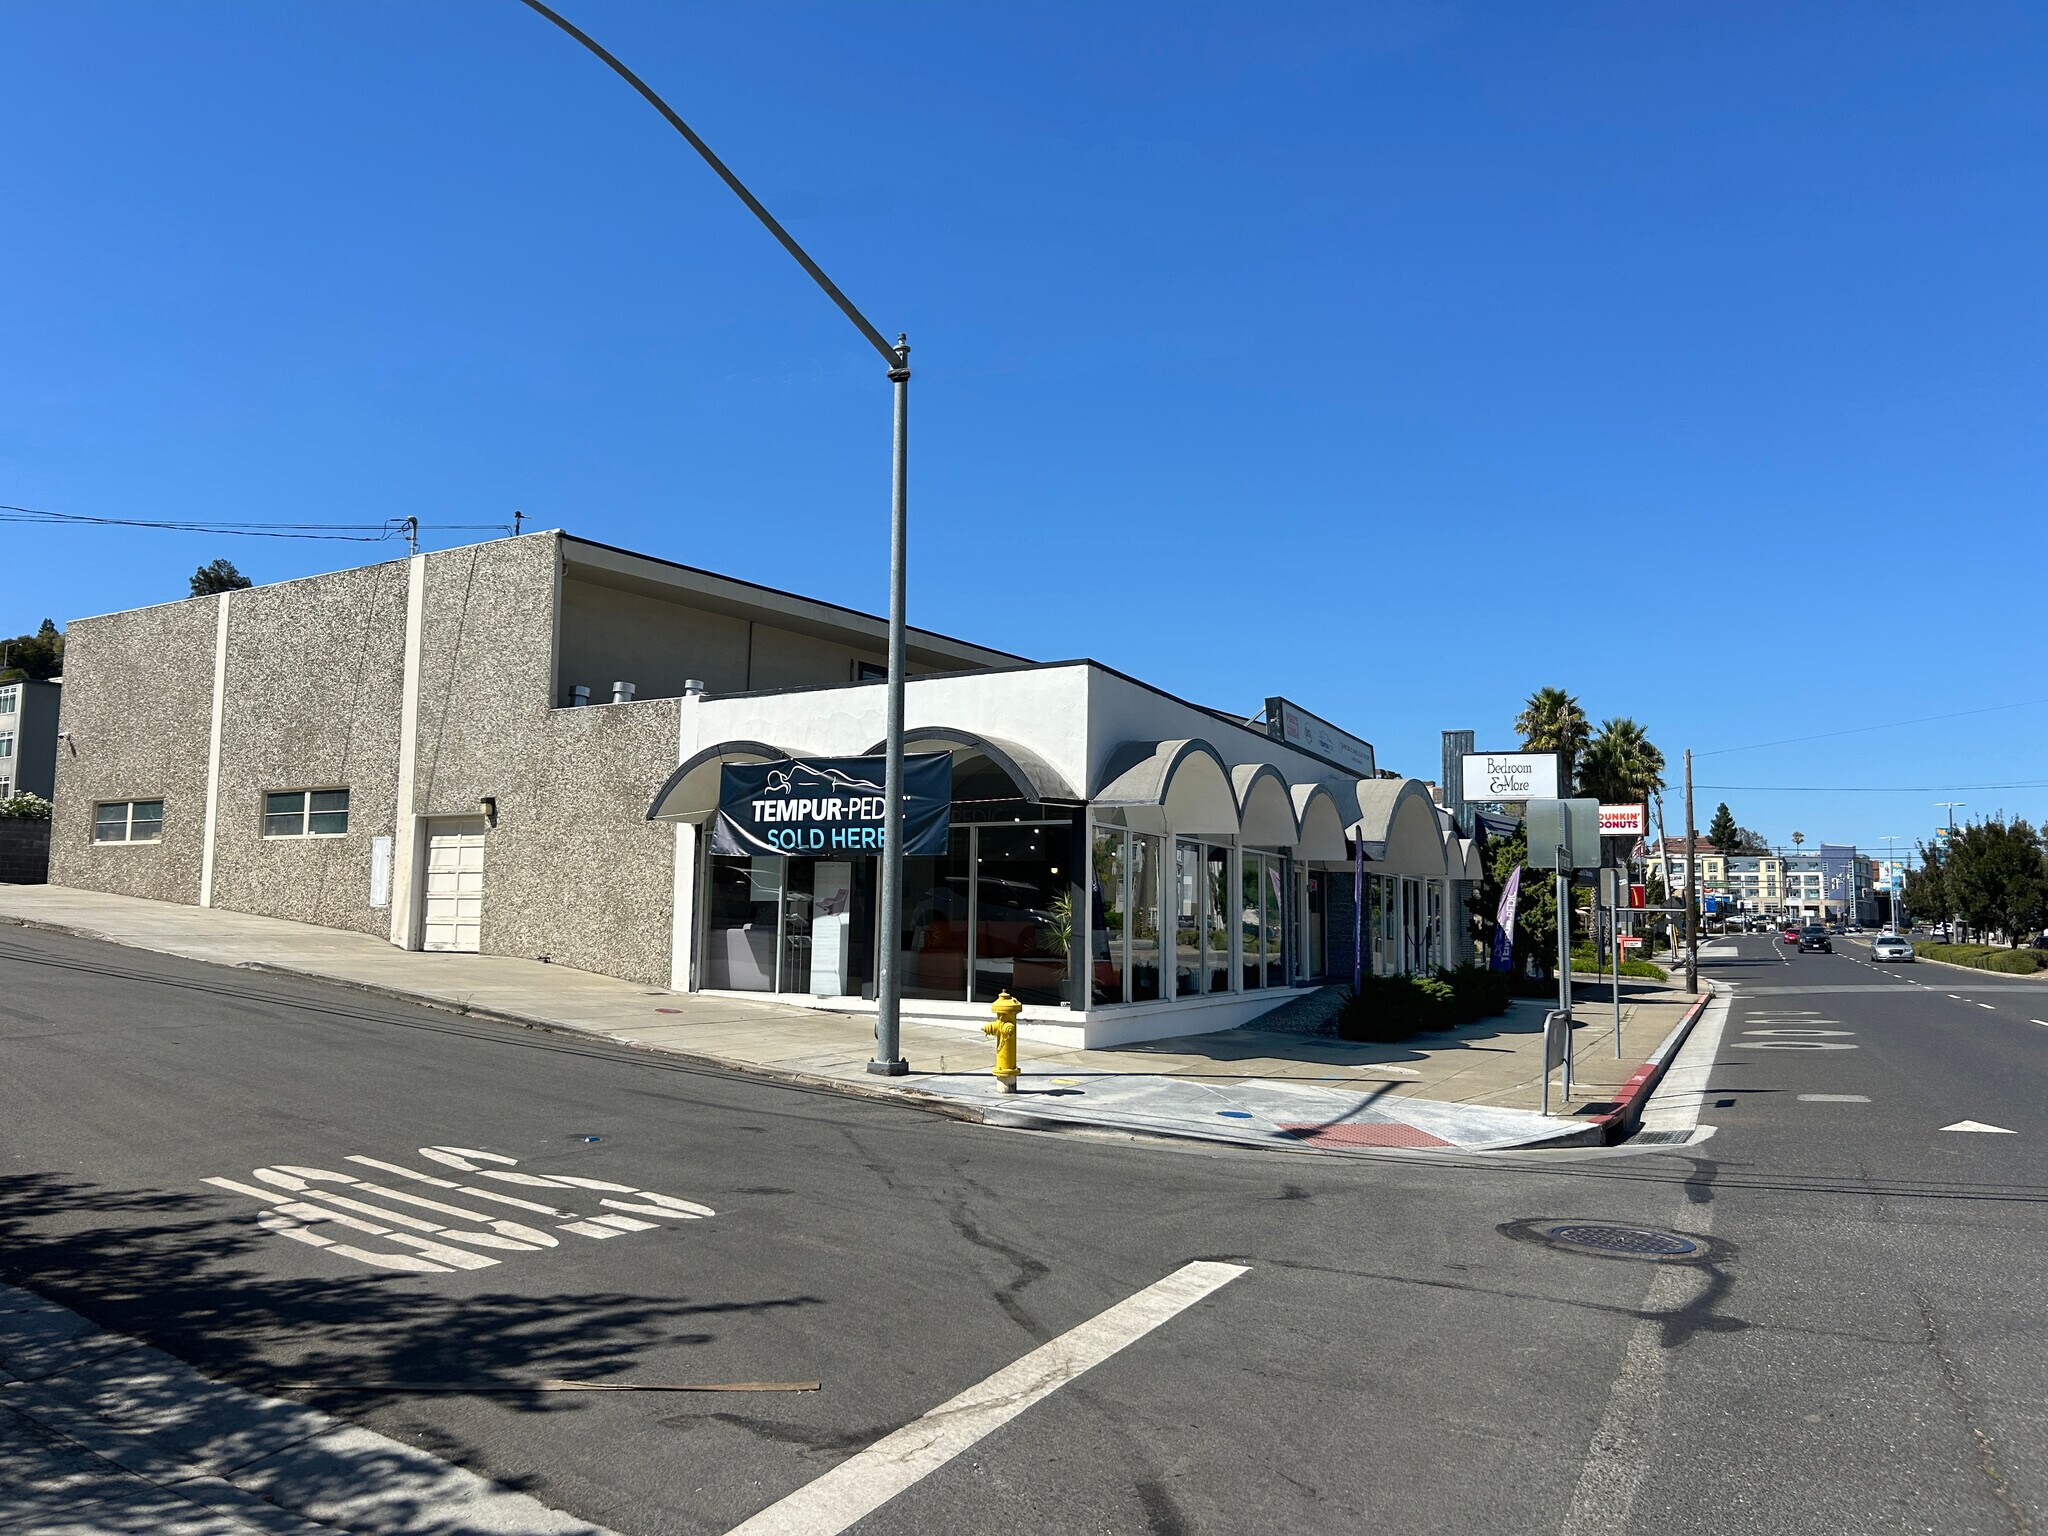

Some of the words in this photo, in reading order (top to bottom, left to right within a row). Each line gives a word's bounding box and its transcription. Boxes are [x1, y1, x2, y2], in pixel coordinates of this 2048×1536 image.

[1487, 757, 1533, 774] Bedroom
[752, 795, 906, 822] TEMPUR-PED
[1598, 820, 1639, 829] DONUTS
[767, 828, 825, 850] SOLD
[831, 826, 886, 849] HERE
[199, 1145, 716, 1273] STOP
